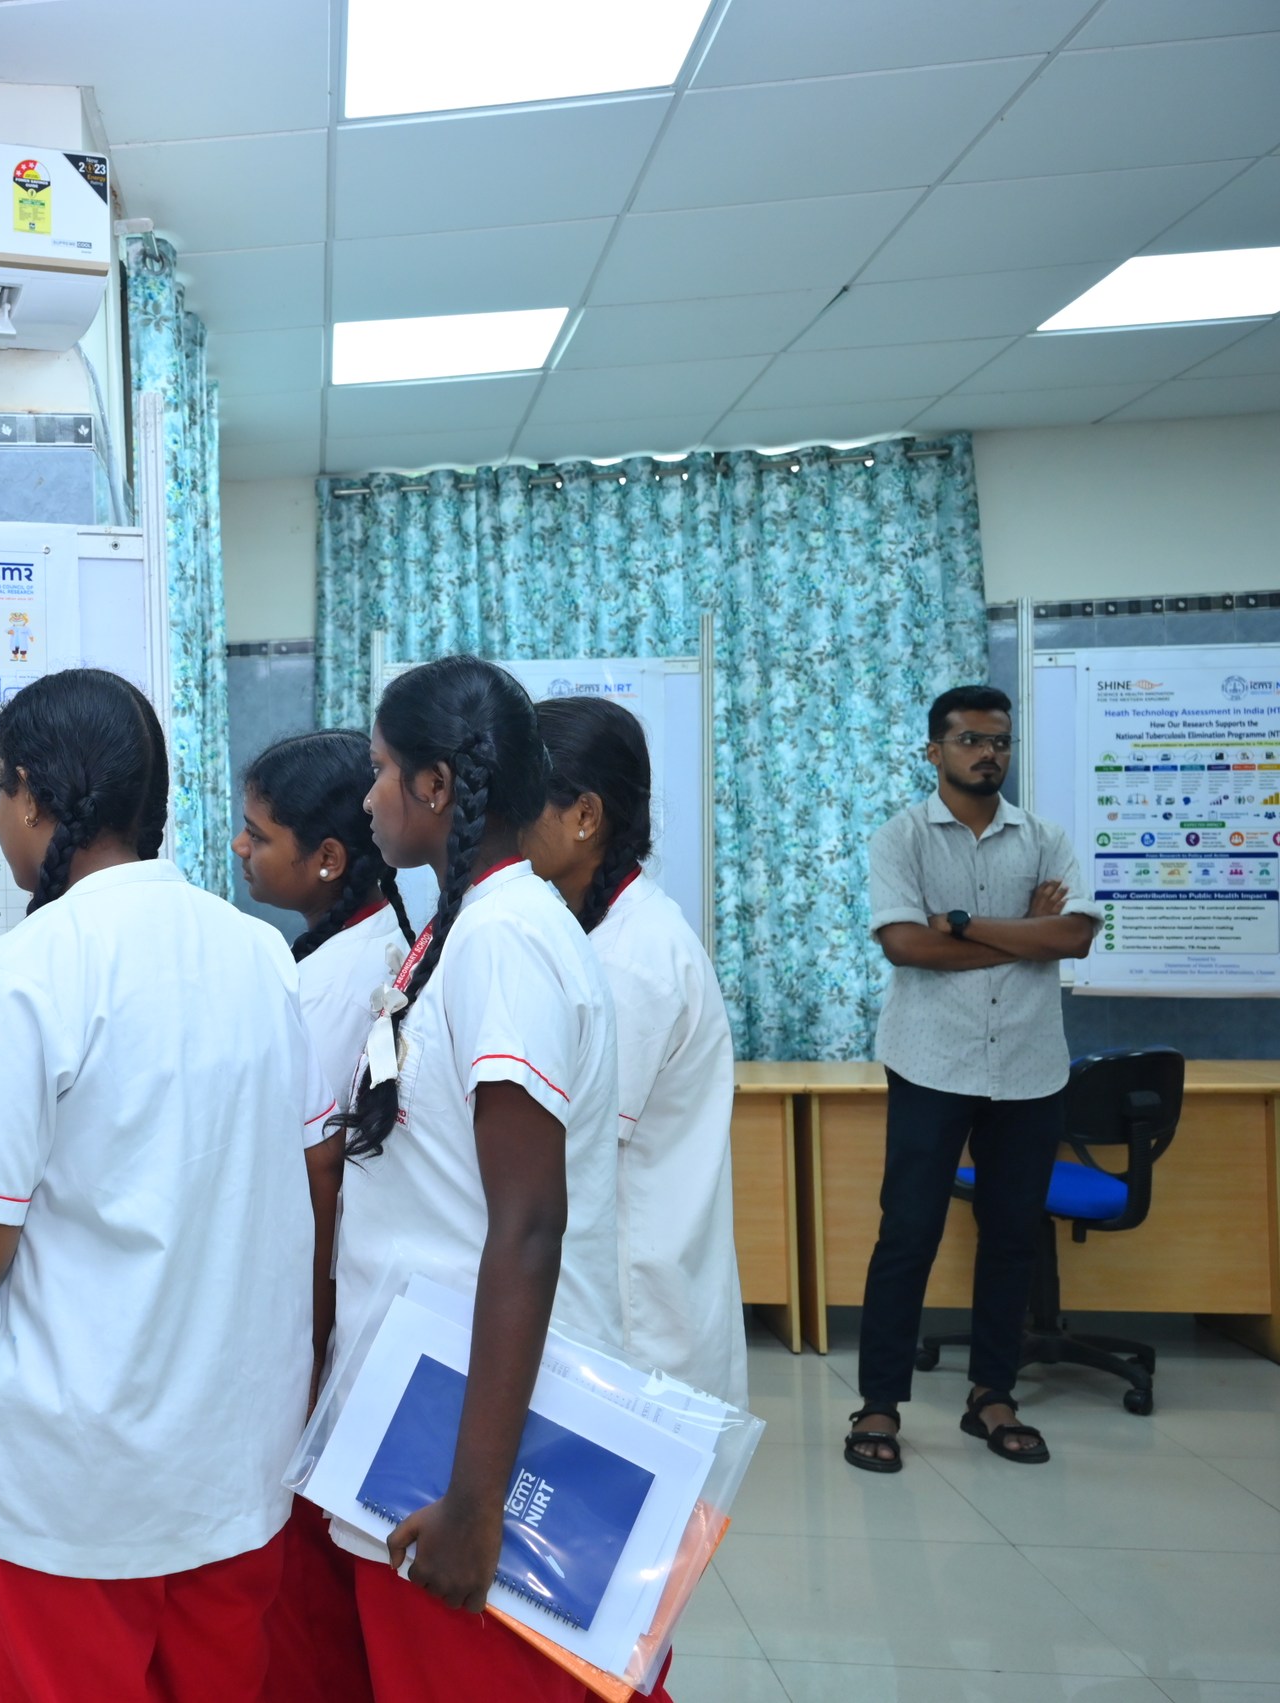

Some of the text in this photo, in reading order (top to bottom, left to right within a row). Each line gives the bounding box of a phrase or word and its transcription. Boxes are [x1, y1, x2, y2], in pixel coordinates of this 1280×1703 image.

[1097, 681, 1132, 691] SHINE
[1105, 709, 1129, 717] Heath
[1132, 708, 1178, 718] Technology
[1181, 708, 1231, 716] Assessment
[1244, 707, 1265, 715] India
[1267, 706, 1280, 716] (HT
[1150, 721, 1166, 729] How
[1182, 720, 1214, 728] Research
[1215, 720, 1245, 729] Supports
[1248, 720, 1258, 728] the
[1116, 729, 1280, 740] National Tuberculosis Elimination Programme (NT
[1241, 892, 1267, 900] Impact
[396, 953, 418, 984] SECONDARY
[524, 1479, 554, 1528] NIRT
